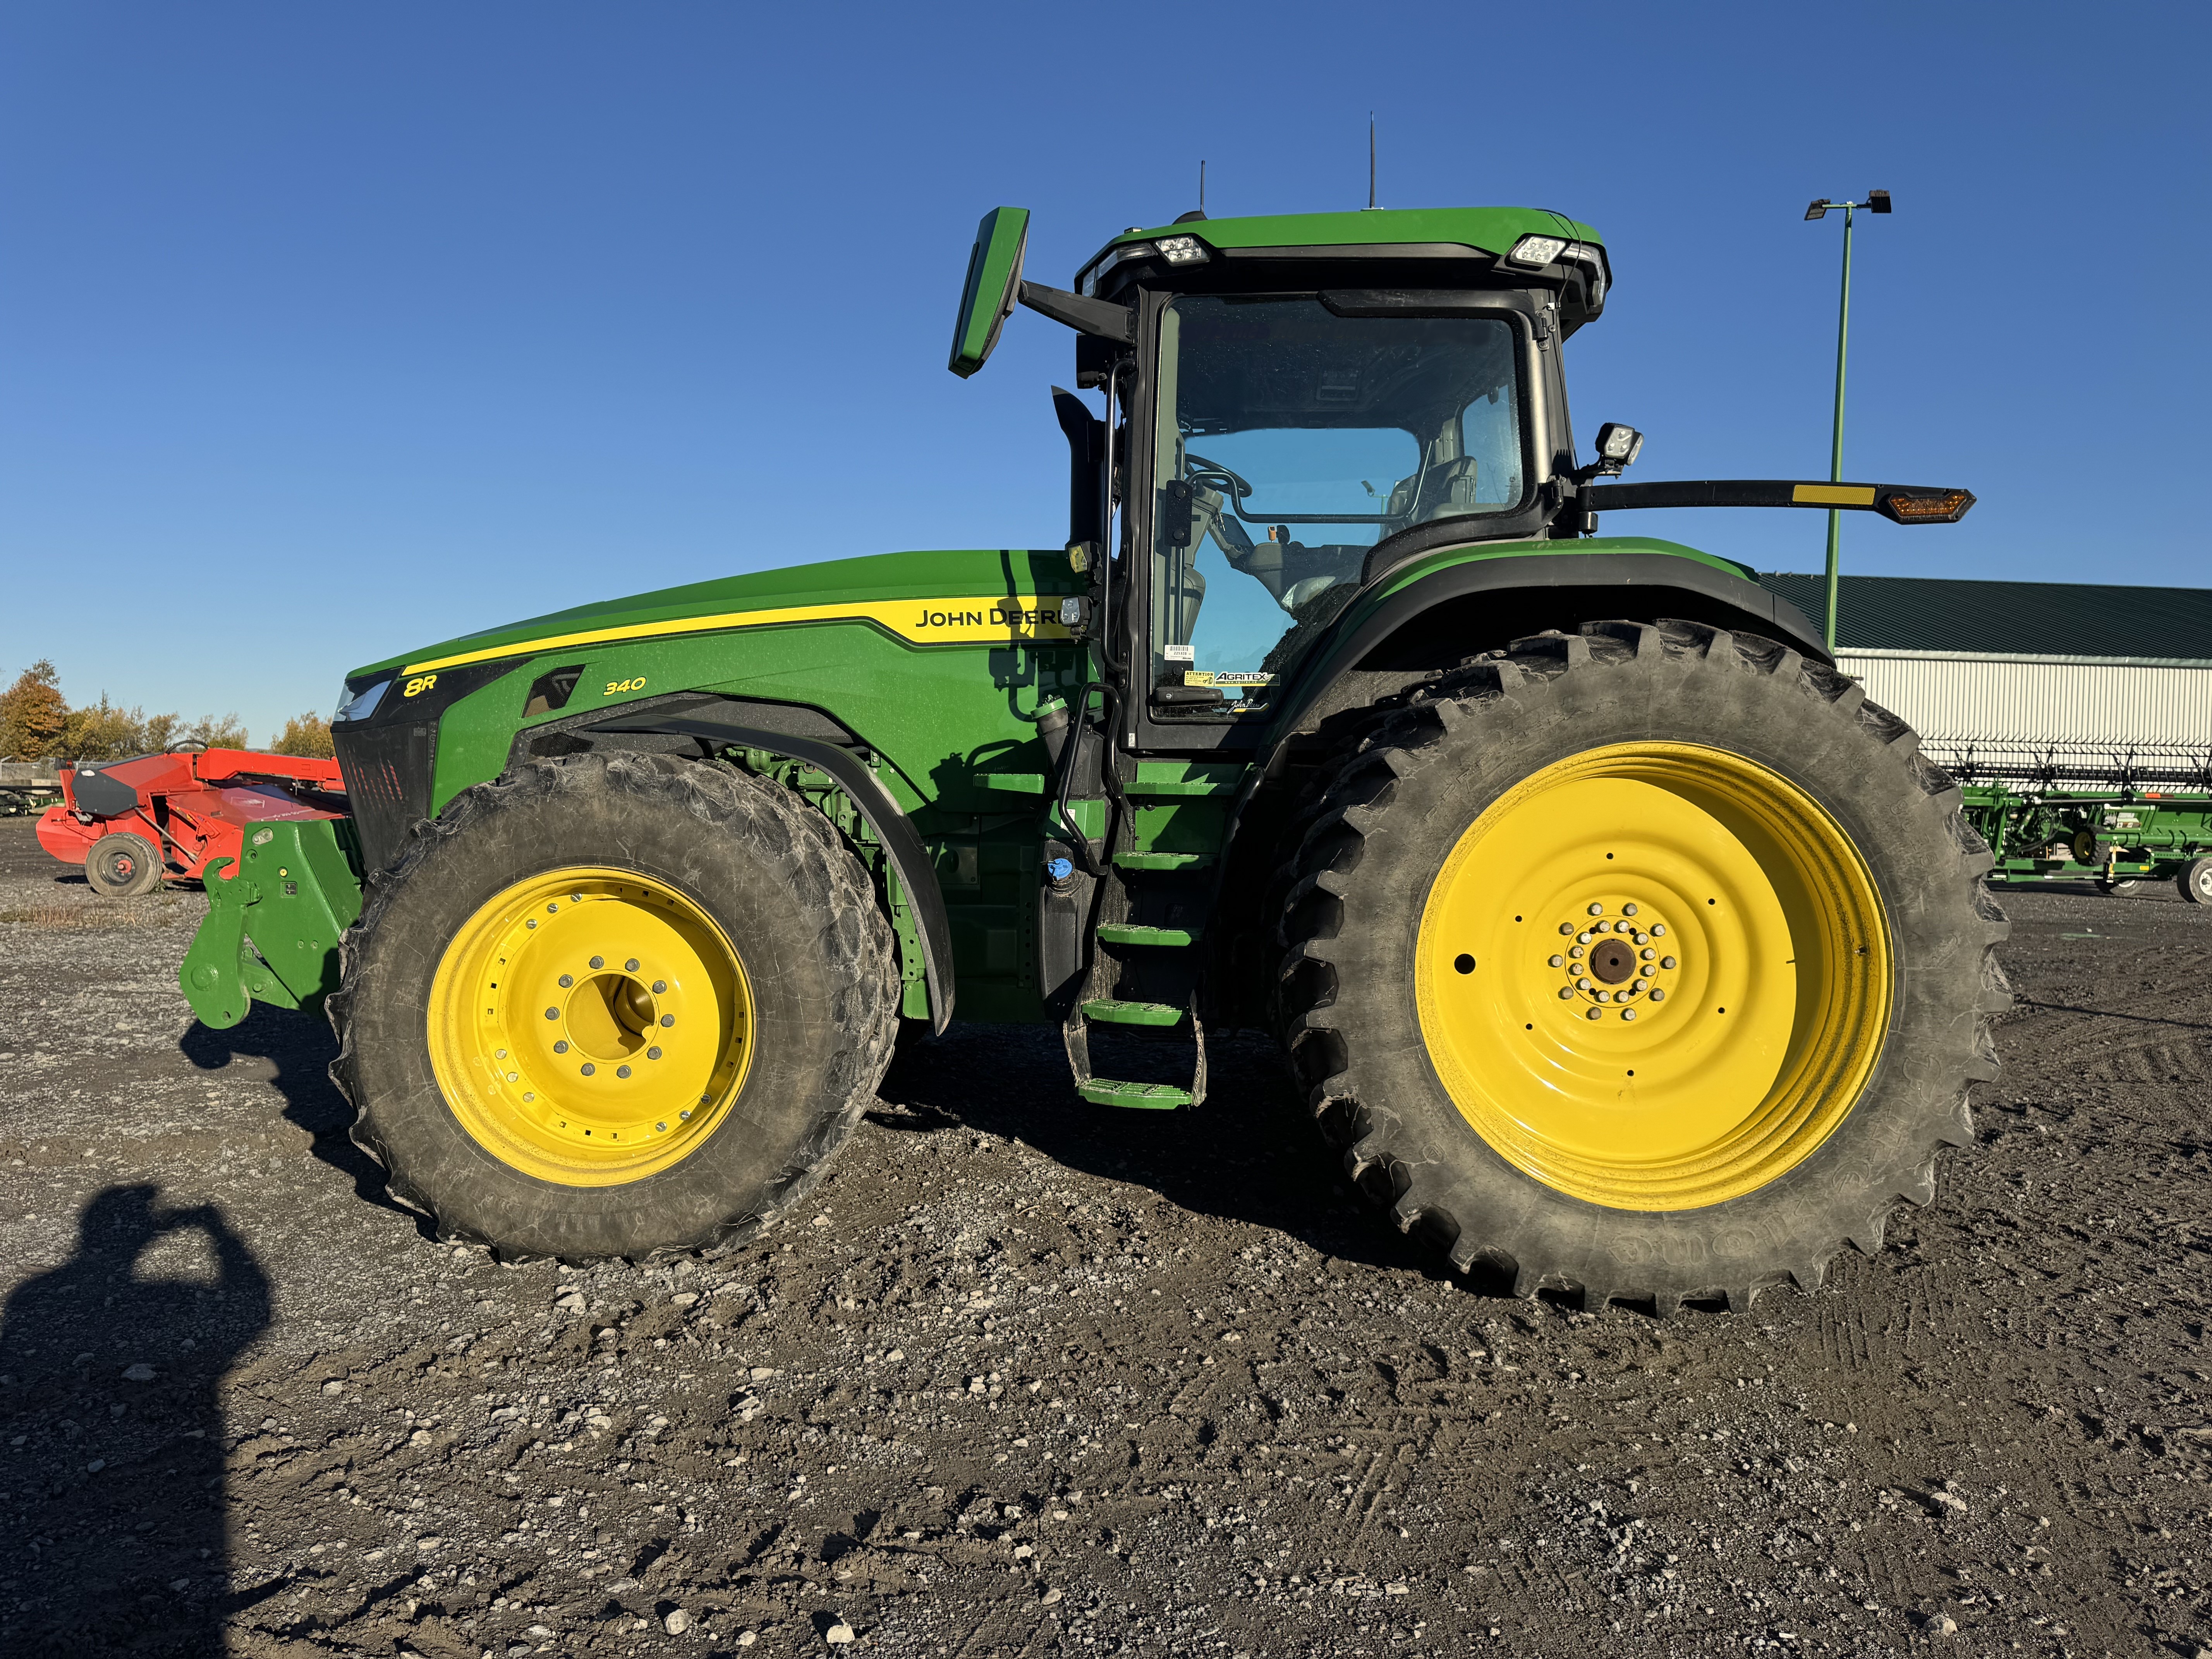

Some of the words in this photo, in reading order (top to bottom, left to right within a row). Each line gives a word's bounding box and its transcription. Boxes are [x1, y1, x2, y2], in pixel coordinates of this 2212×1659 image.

[915, 610, 982, 627] JOHN
[990, 608, 1062, 625] DEER
[404, 675, 437, 697] 8R
[603, 677, 646, 696] 340
[1226, 700, 1246, 714] John
